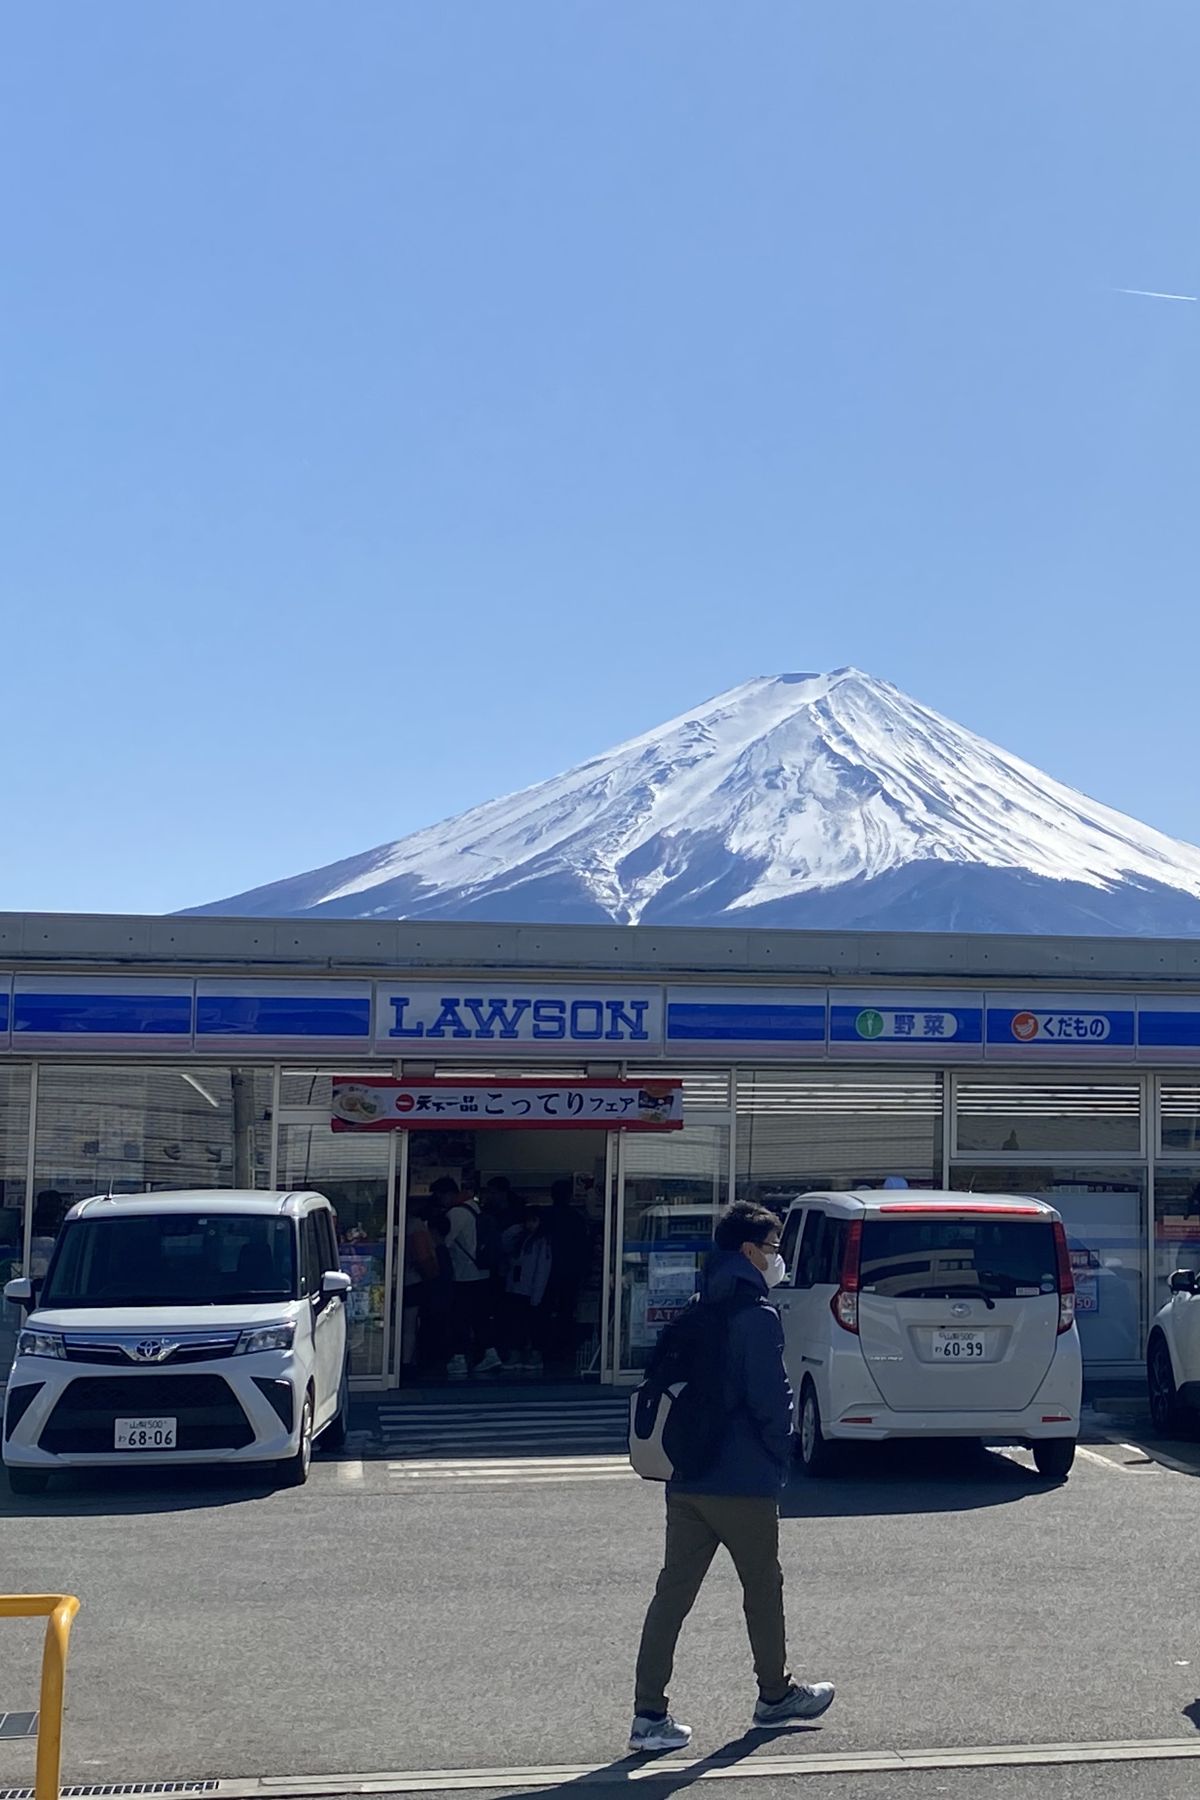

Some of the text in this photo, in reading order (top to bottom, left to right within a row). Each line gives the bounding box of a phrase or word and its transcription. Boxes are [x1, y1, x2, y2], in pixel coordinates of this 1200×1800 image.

[389, 997, 649, 1040] LAWSON
[893, 1014, 945, 1036] 野菜
[1042, 1017, 1106, 1038] くだもの
[943, 1342, 983, 1357] 60-99
[128, 1430, 173, 1446] 68-06
